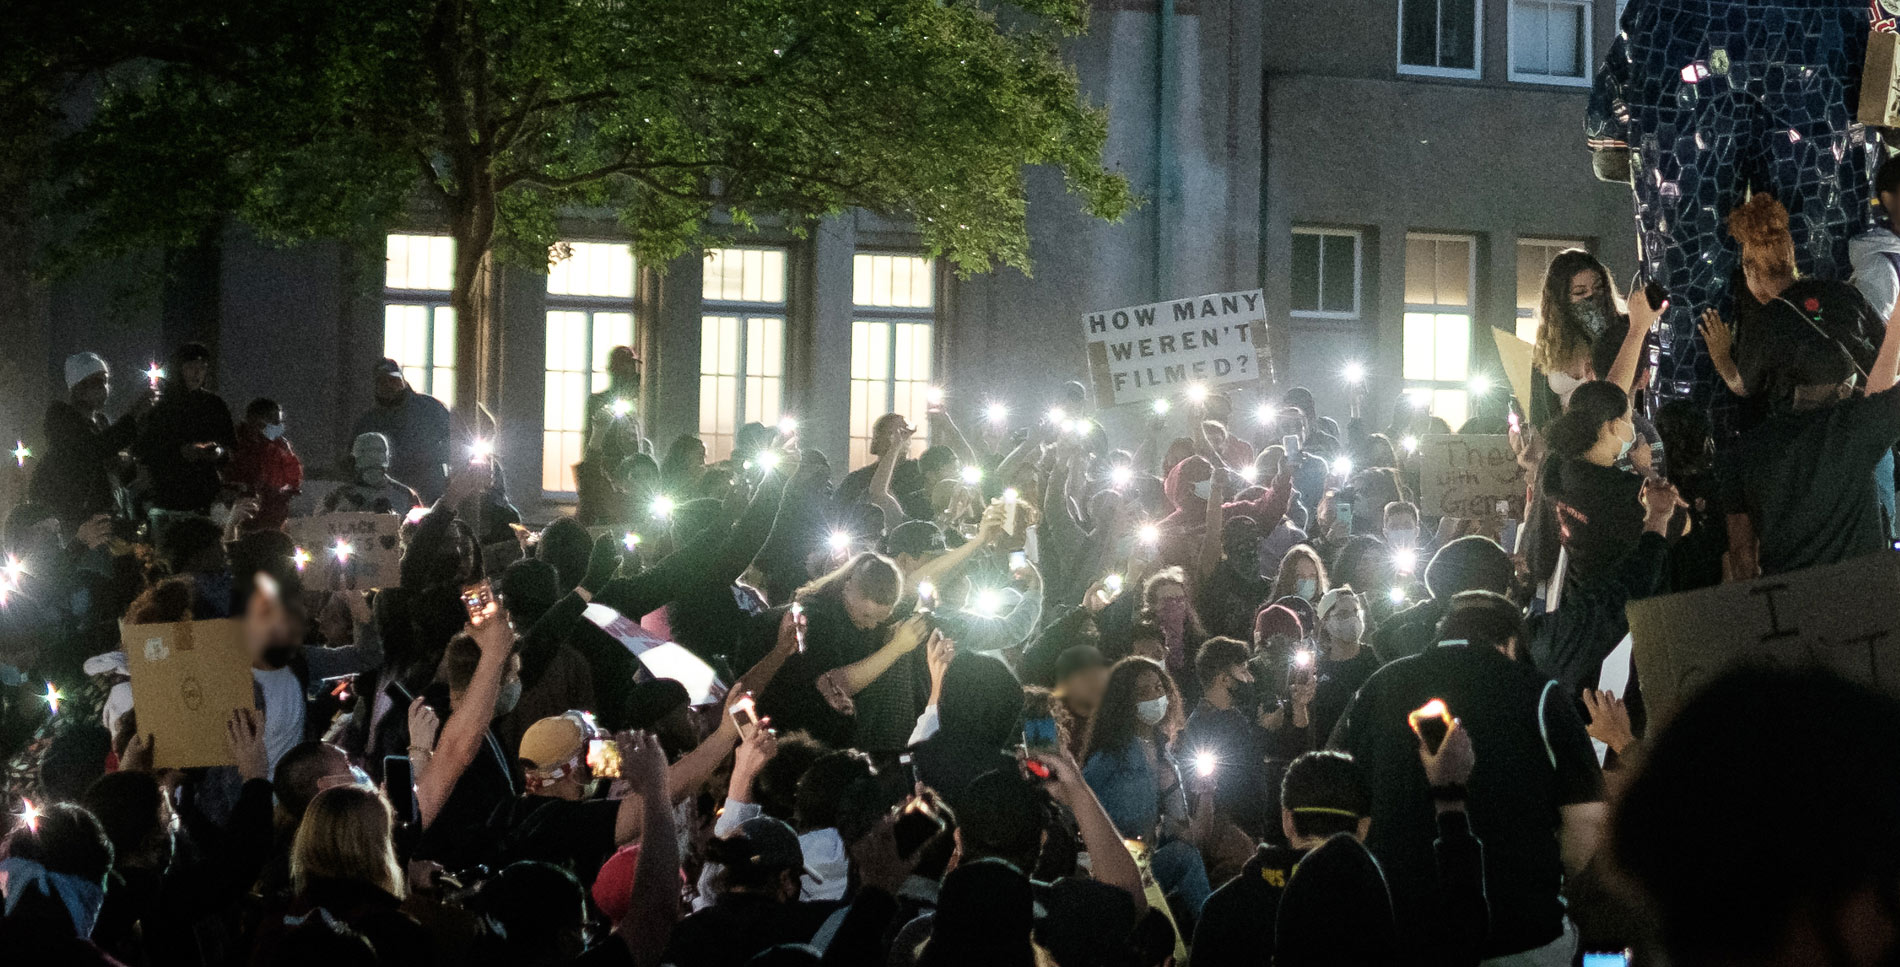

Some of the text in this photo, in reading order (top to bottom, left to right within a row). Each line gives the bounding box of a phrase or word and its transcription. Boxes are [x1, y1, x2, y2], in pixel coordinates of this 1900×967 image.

[1089, 293, 1258, 334] HOW MANY
[1110, 323, 1250, 362] WEREN'T
[1112, 354, 1249, 392] FILMED?
[1750, 583, 1800, 643] I
